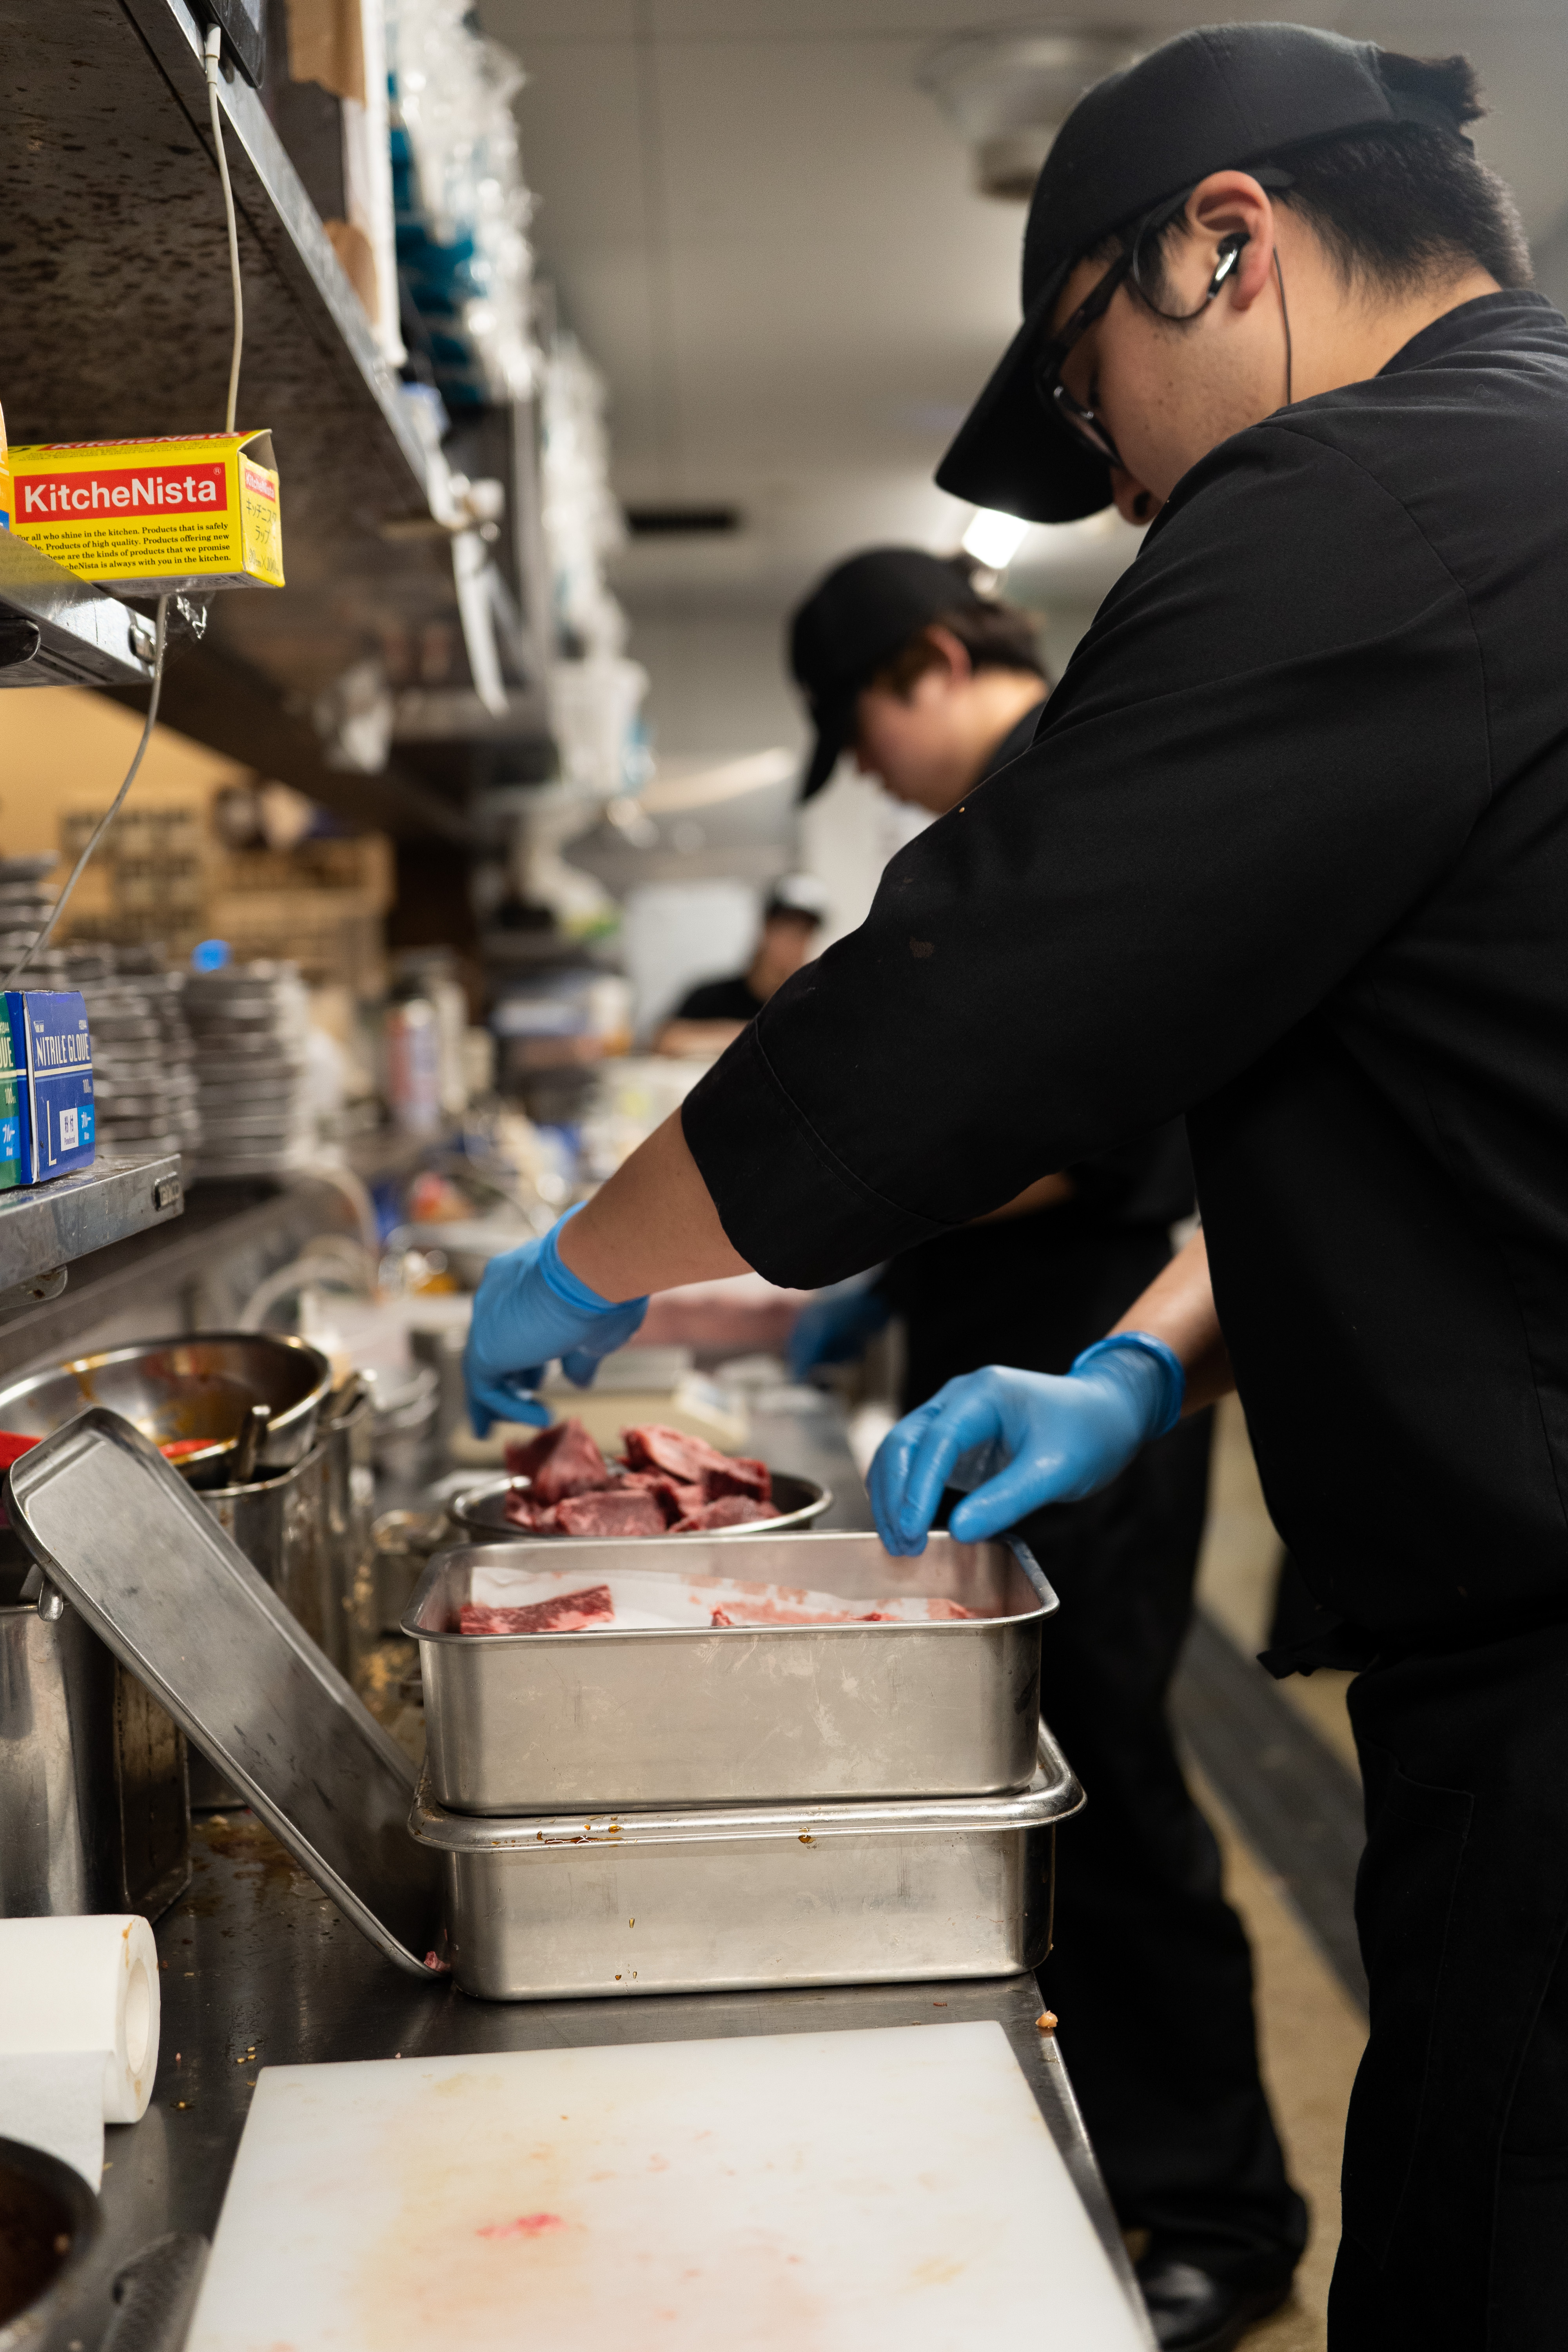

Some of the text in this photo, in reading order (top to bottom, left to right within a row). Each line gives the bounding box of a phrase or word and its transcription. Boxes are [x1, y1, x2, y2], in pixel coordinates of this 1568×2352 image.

[24, 477, 216, 512] KitcheNista
[92, 540, 109, 549] high
[111, 539, 141, 547] quality.
[143, 536, 178, 544] Products
[130, 548, 165, 557] products
[198, 544, 230, 553] promise
[36, 1035, 67, 1067] NITRILE
[64, 1135, 75, 1146] Powdered
